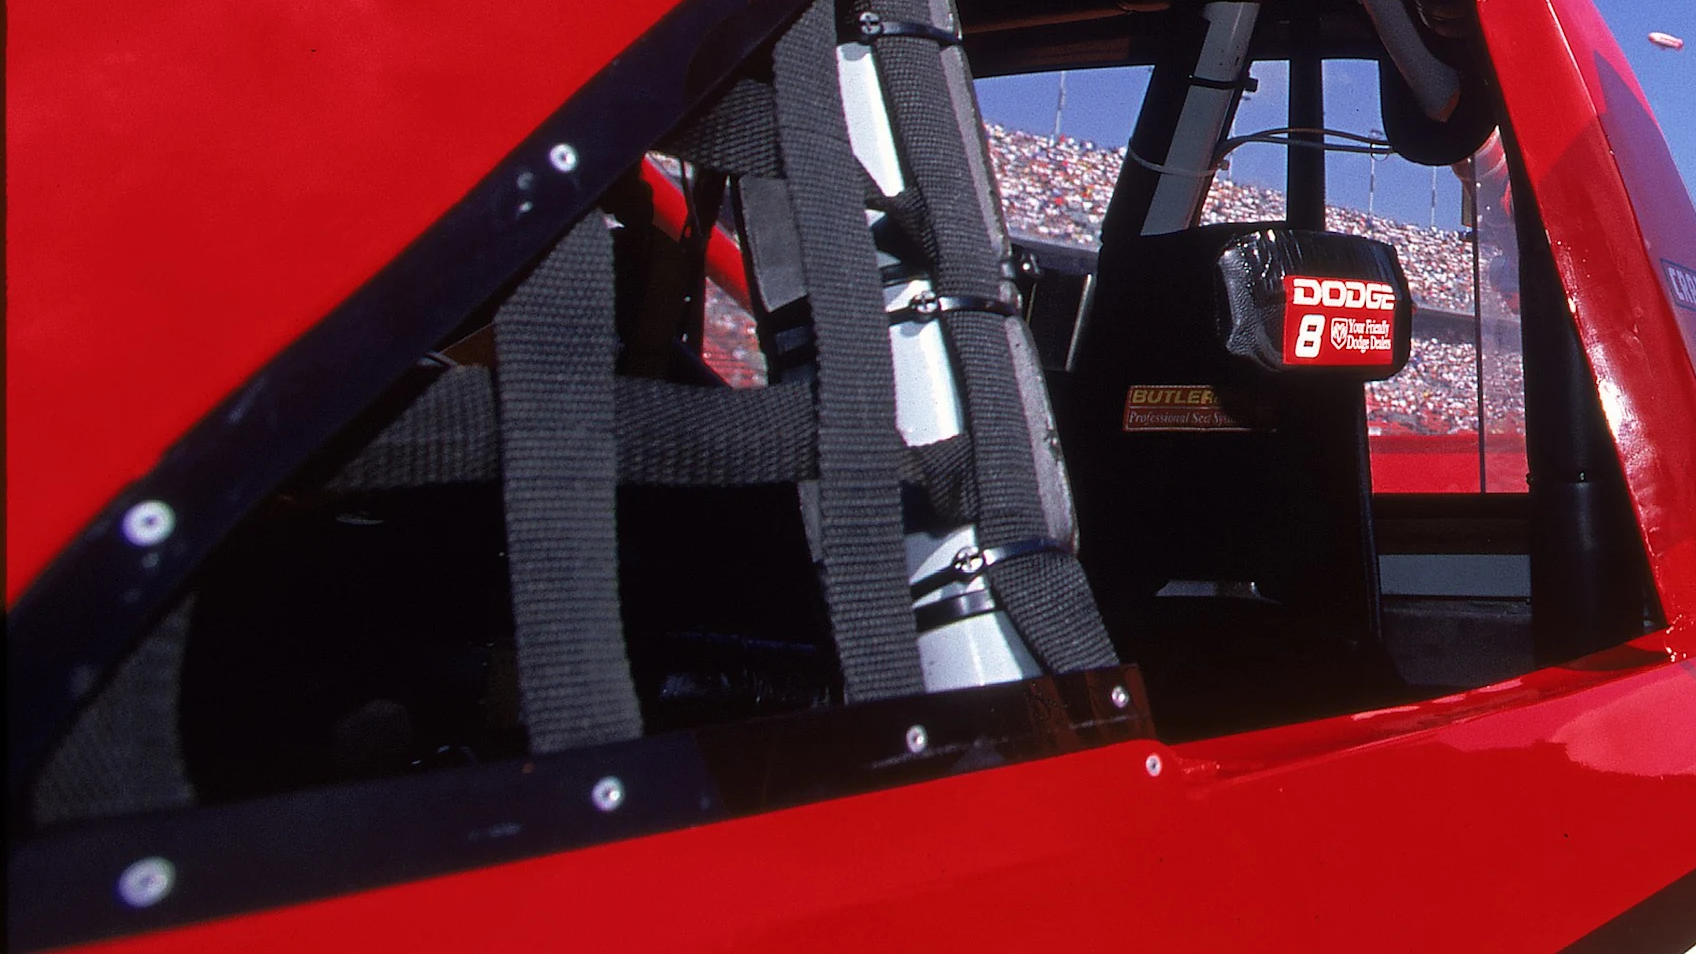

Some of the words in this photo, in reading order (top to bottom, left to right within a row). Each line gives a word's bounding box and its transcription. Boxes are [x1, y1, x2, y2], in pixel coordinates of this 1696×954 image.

[1293, 278, 1396, 310] DODGE
[1295, 314, 1326, 358] 8
[1348, 318, 1366, 334] Your
[1366, 319, 1390, 338] Friendly
[1346, 335, 1370, 354] Dodge
[1370, 335, 1391, 350] Dealers
[1128, 411, 1189, 425] Professional
[1191, 412, 1211, 424] Seat
